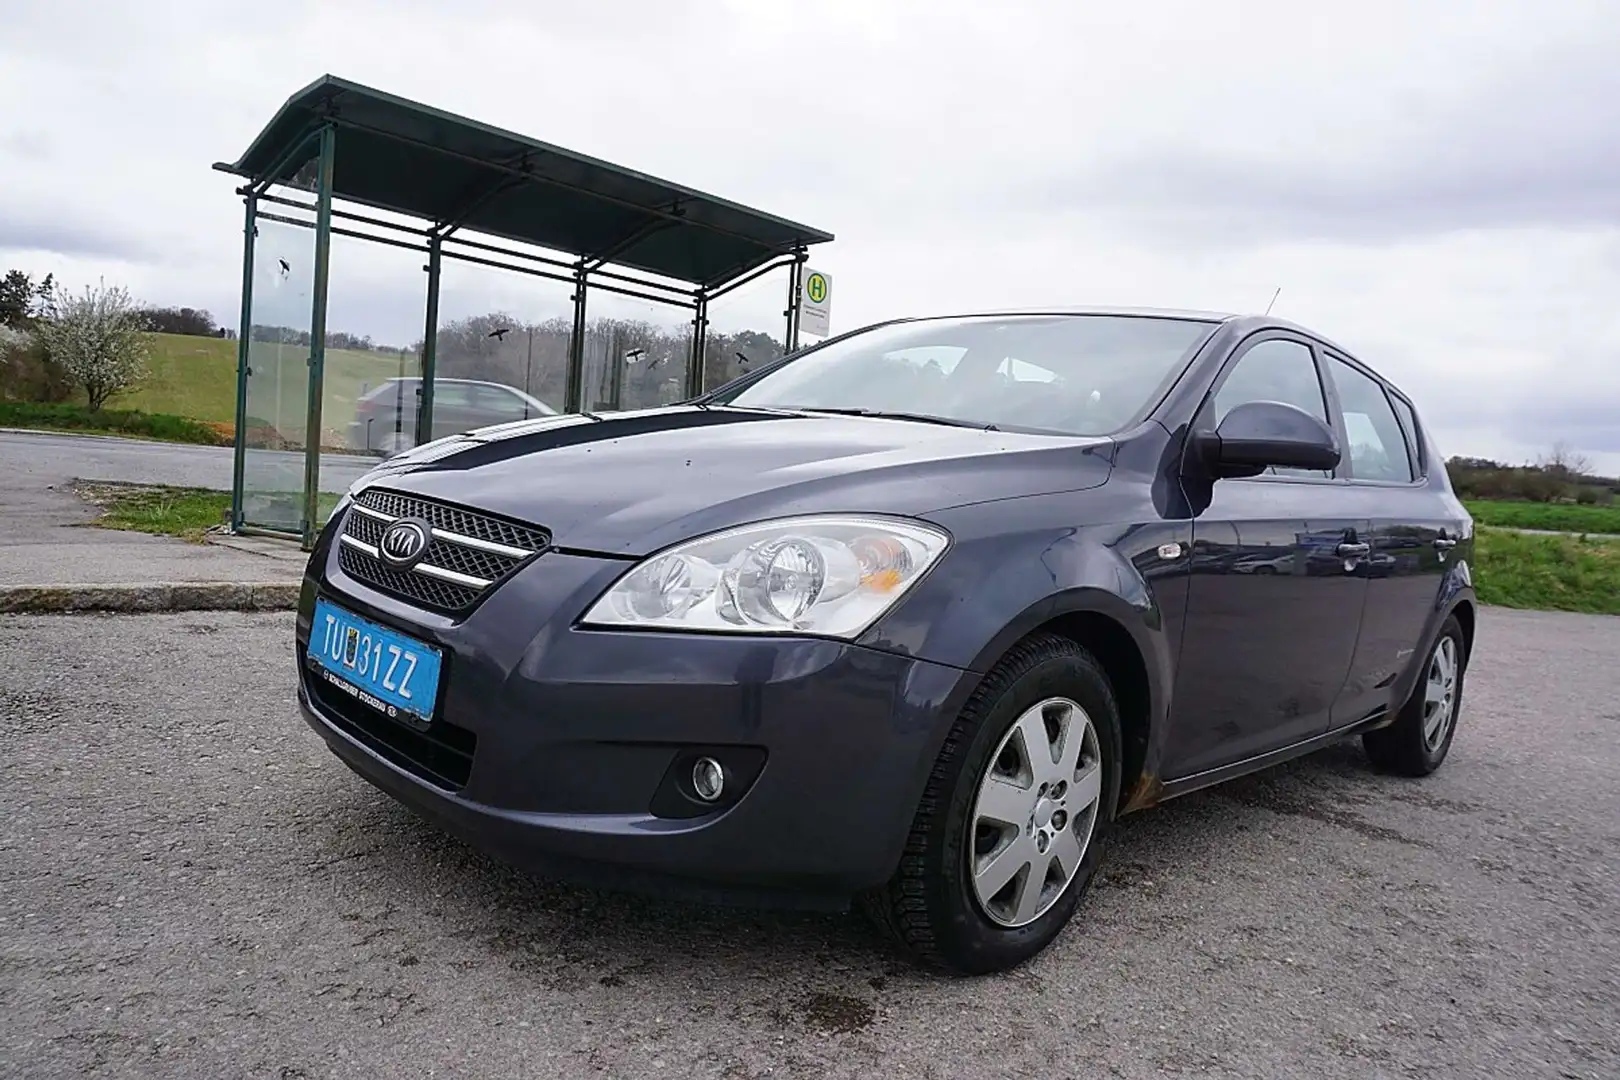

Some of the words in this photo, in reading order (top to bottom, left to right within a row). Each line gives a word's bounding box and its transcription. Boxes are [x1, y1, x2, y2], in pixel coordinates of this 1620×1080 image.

[812, 277, 823, 298] H
[386, 529, 415, 556] KIA
[323, 614, 347, 661] TU
